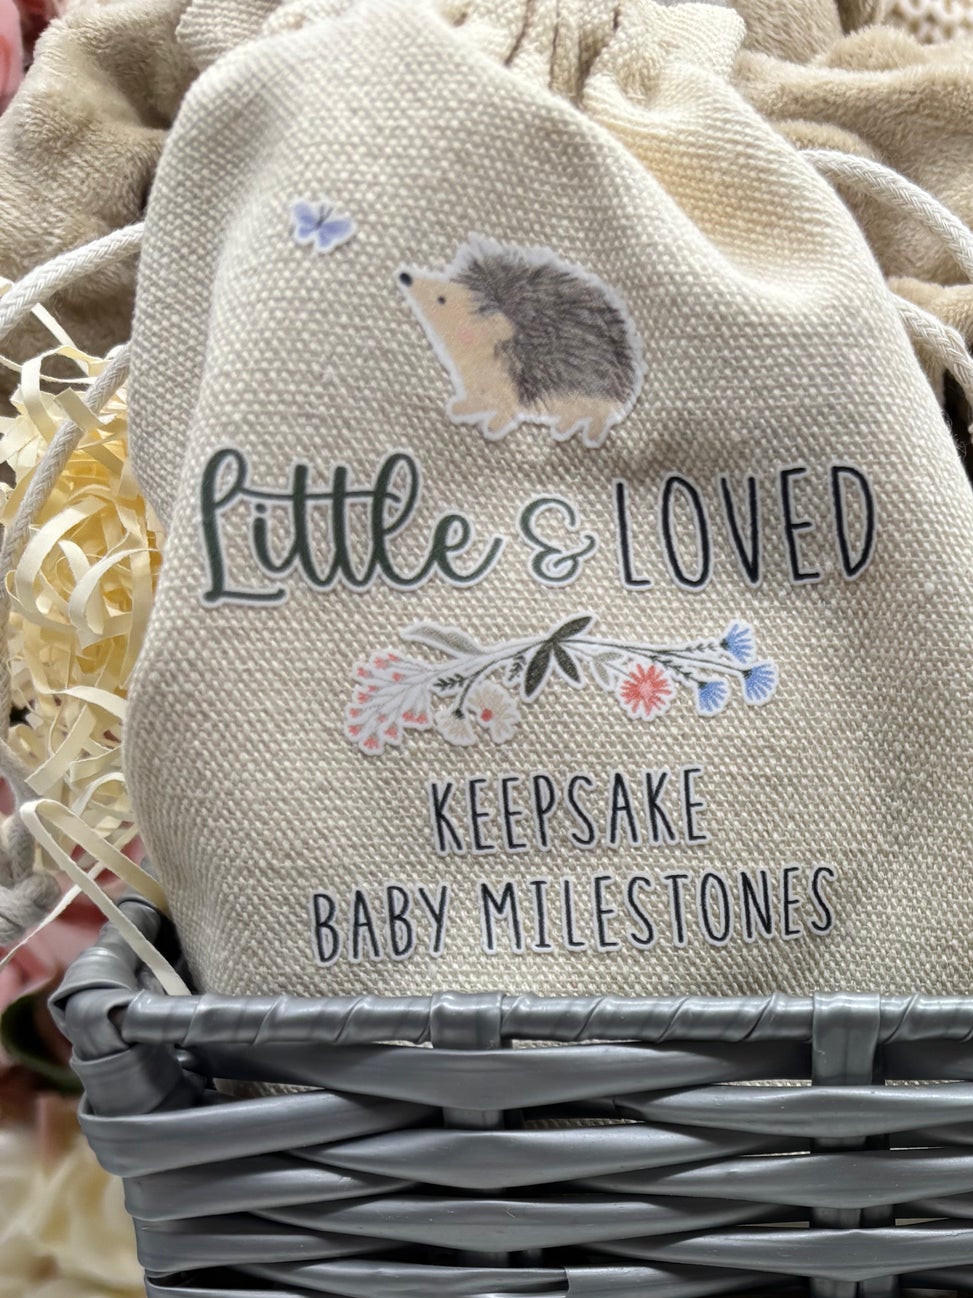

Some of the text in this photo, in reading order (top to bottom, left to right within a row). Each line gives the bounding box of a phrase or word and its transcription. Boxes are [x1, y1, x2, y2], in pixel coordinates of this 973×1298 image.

[202, 448, 878, 602] Little & LOVED
[429, 767, 708, 855] KEEPSAKE
[312, 866, 837, 964] BABY MILESTONES
